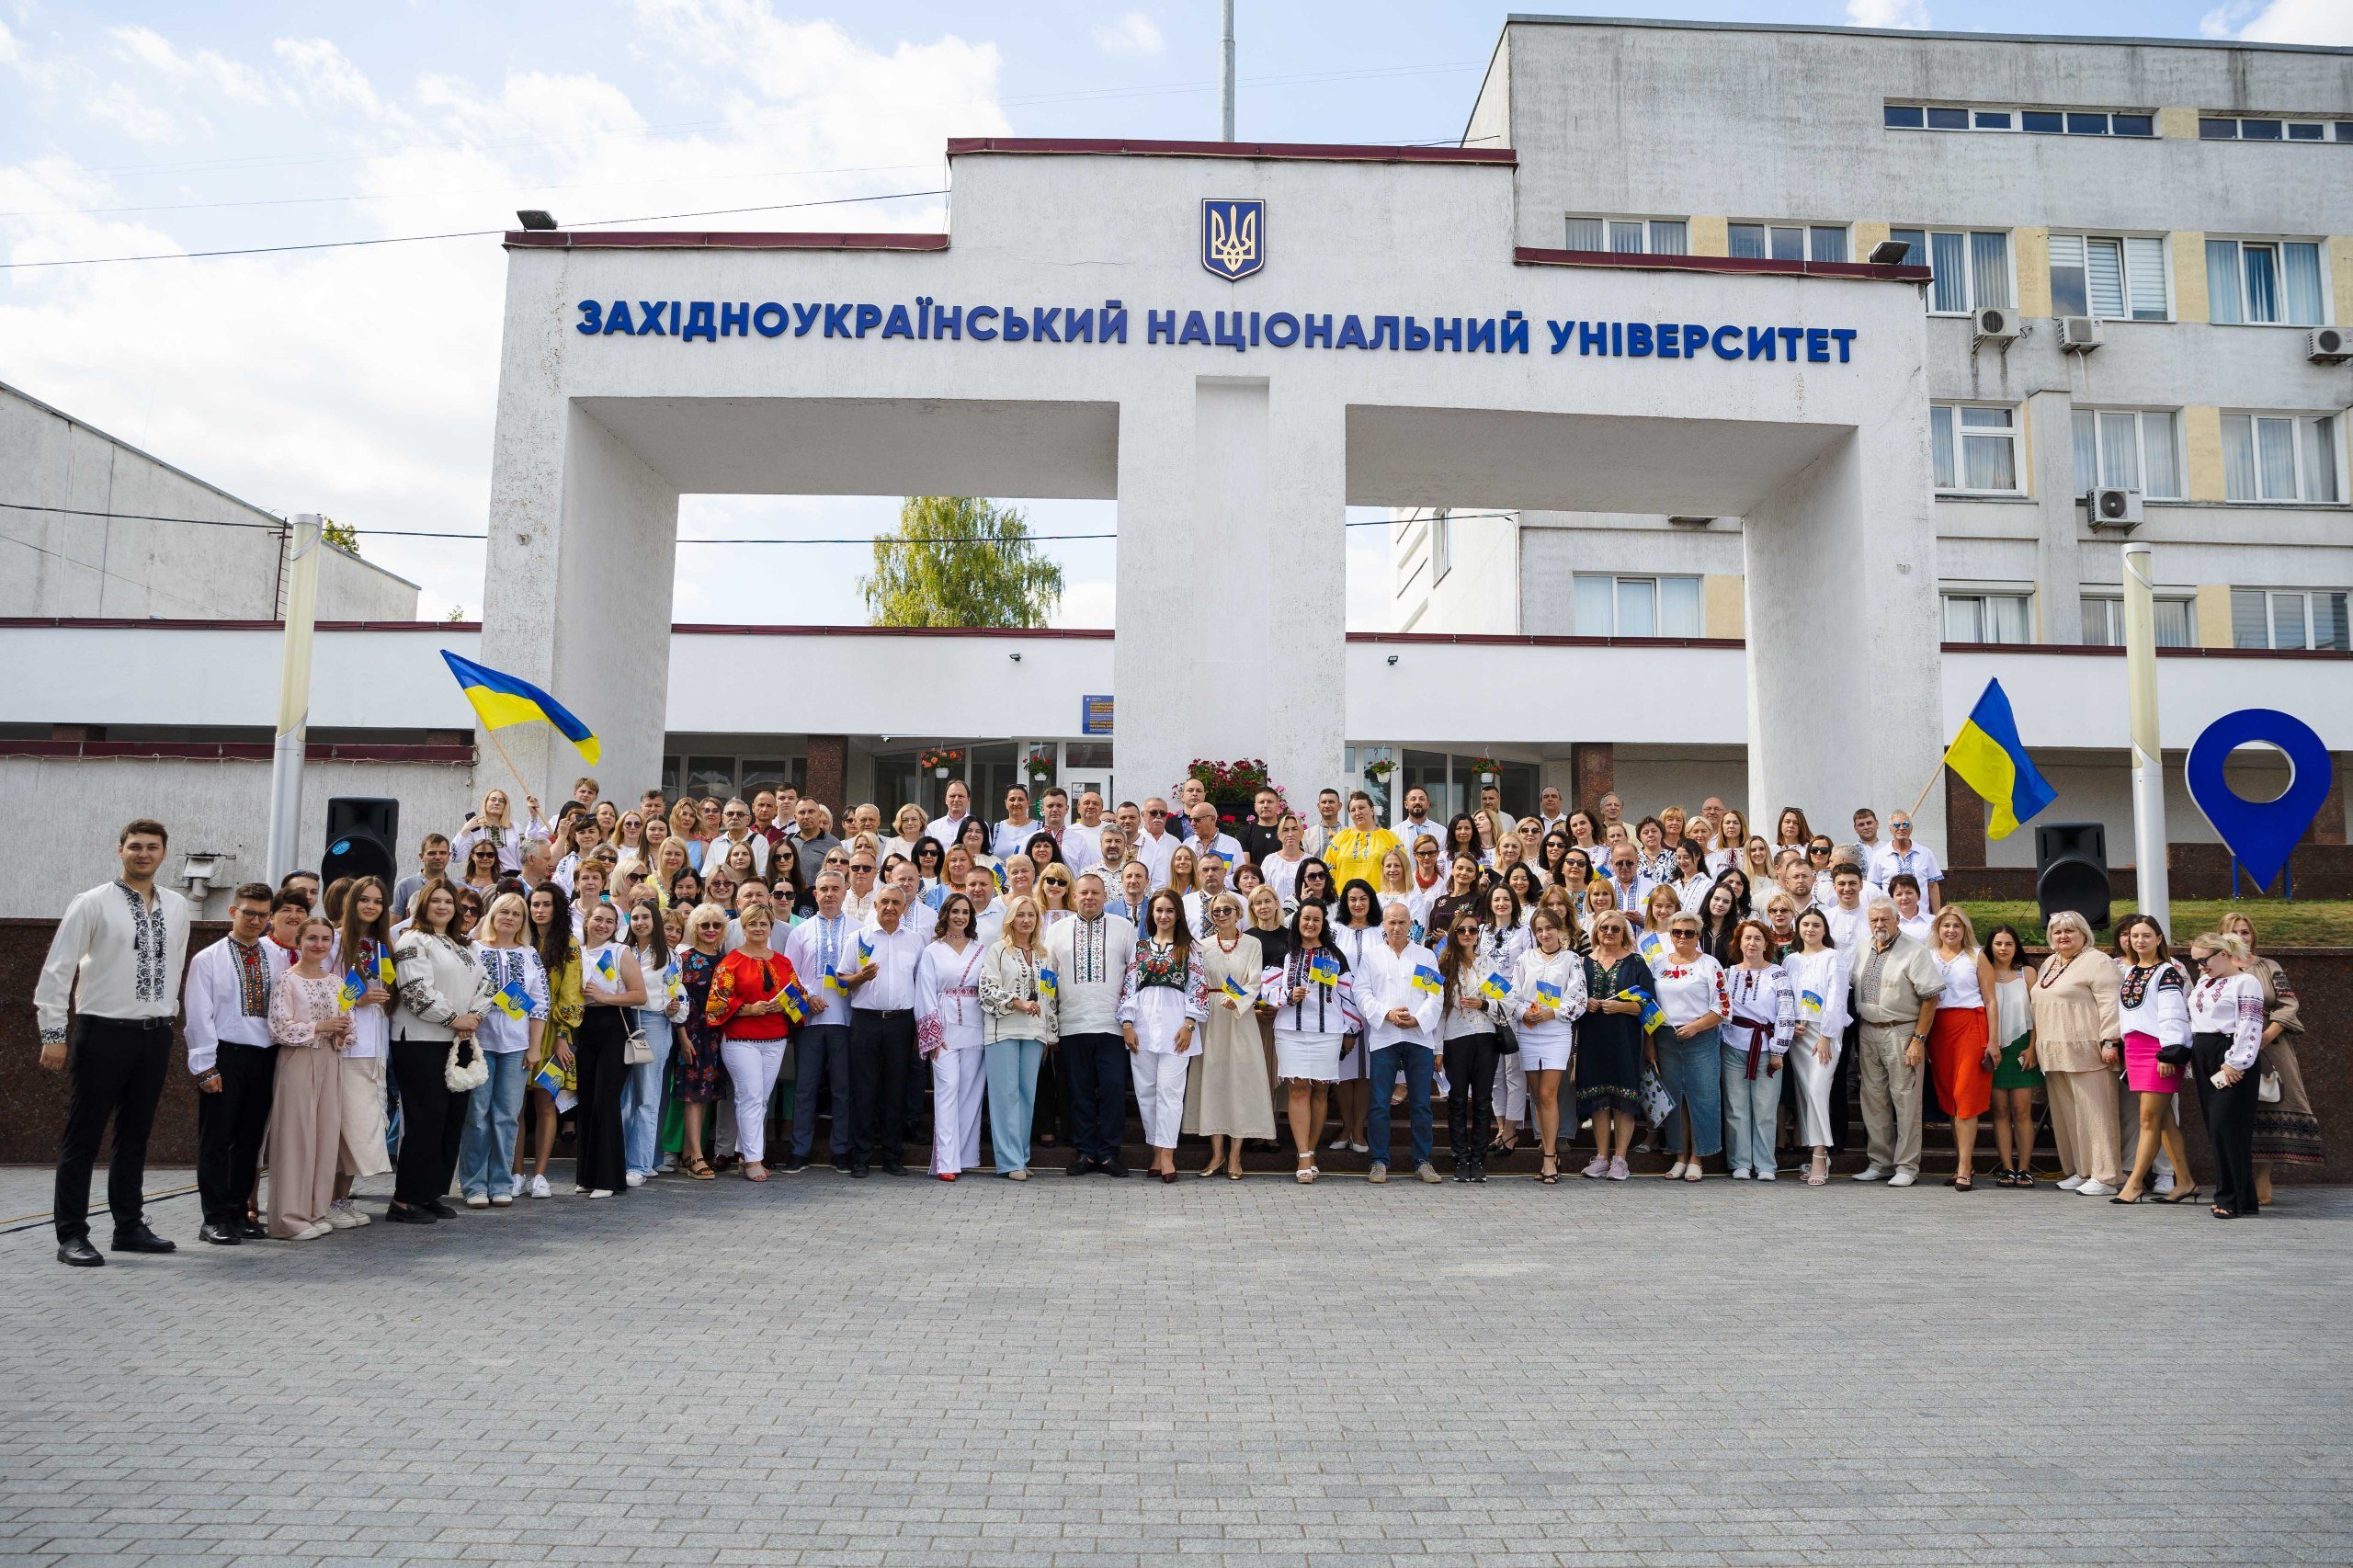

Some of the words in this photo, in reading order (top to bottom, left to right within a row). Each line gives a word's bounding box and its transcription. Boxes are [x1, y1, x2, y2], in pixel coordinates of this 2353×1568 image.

[576, 296, 1127, 343] ЗАХІДНОУКРАЇНСЬКИЙ
[1148, 310, 1529, 353] НАЦІОНАЛЬНИЙ
[1547, 321, 1858, 362] УНІВЕРСИТЕТ
